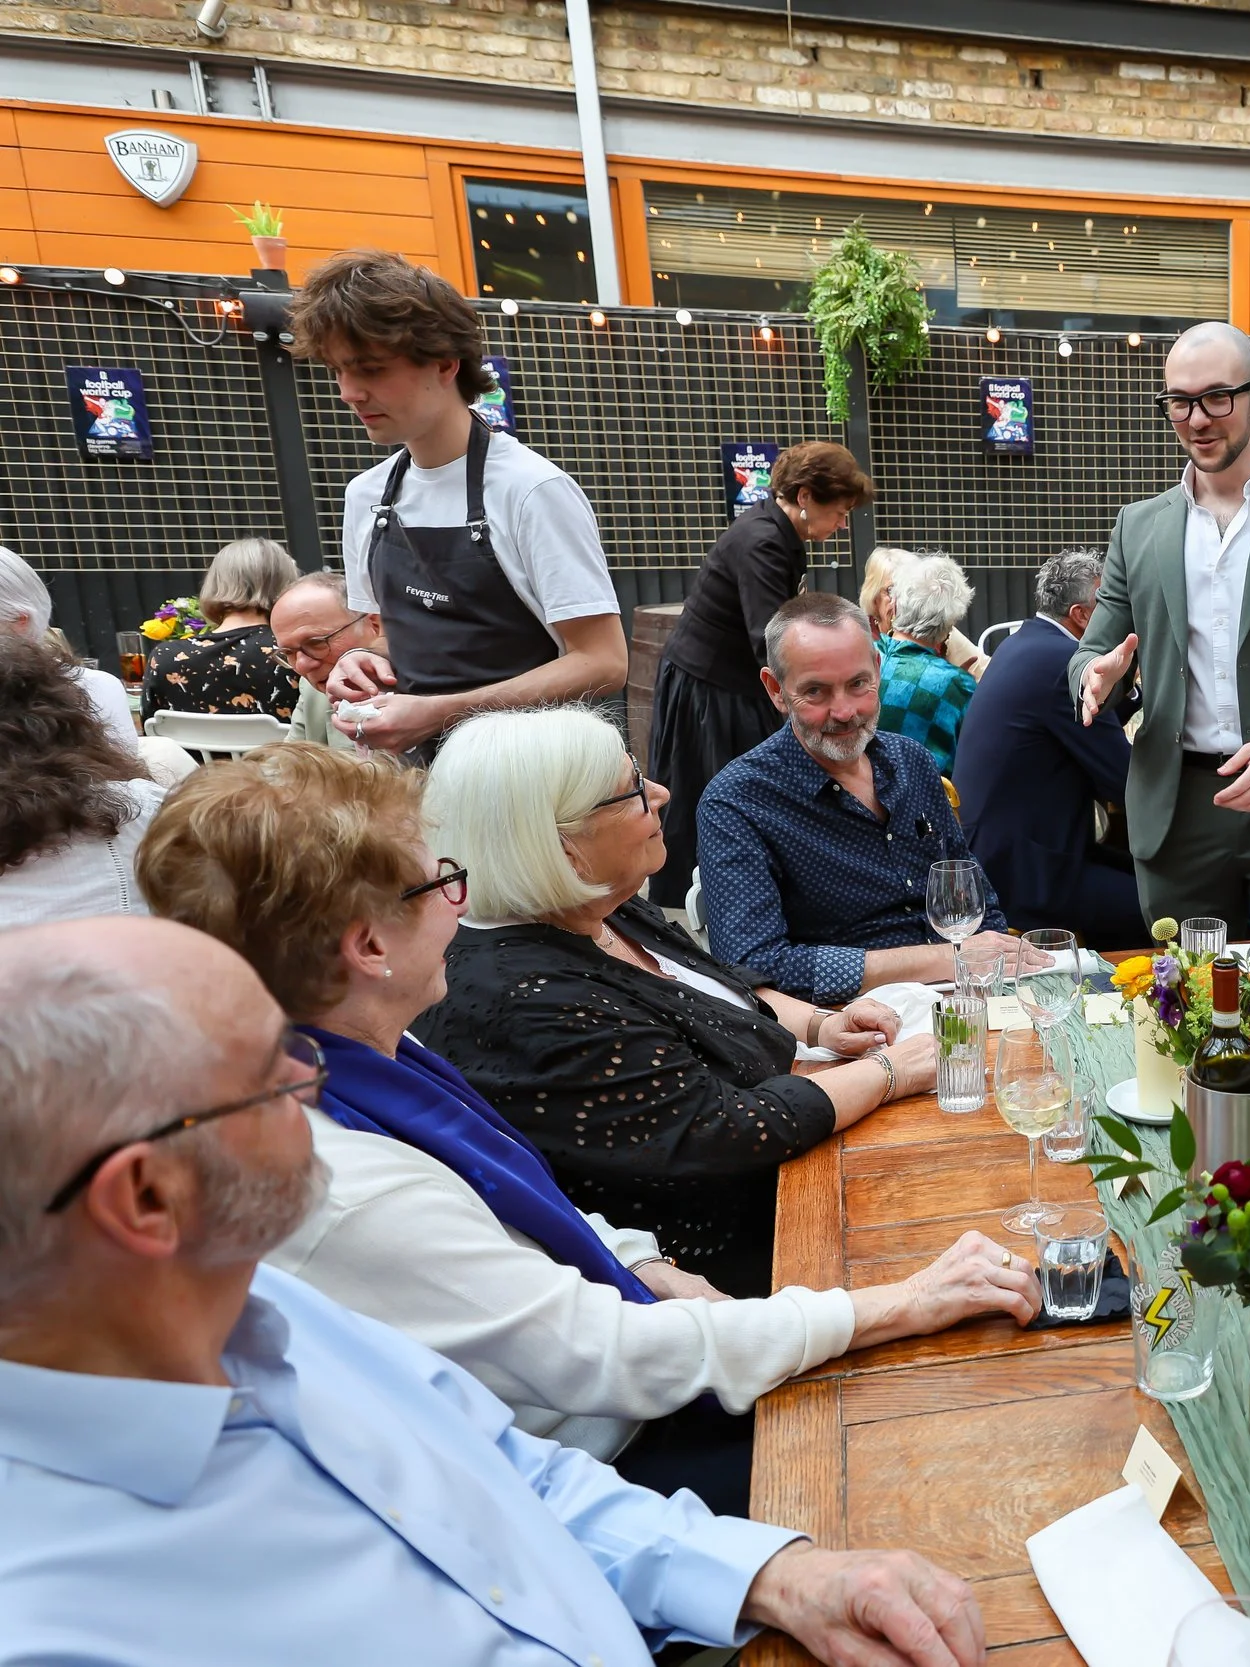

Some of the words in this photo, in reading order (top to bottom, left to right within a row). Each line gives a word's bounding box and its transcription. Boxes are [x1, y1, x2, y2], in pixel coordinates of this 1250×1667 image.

[115, 140, 179, 156] BANHAM
[85, 379, 125, 390] football
[80, 388, 110, 397] world
[111, 389, 133, 399] cup
[990, 391, 1010, 399] world
[1010, 392, 1025, 400] cup
[731, 461, 754, 469] world
[754, 461, 771, 469] cup
[405, 585, 450, 602] FEVER-TREE
[1161, 1294, 1195, 1350] BREWERY
